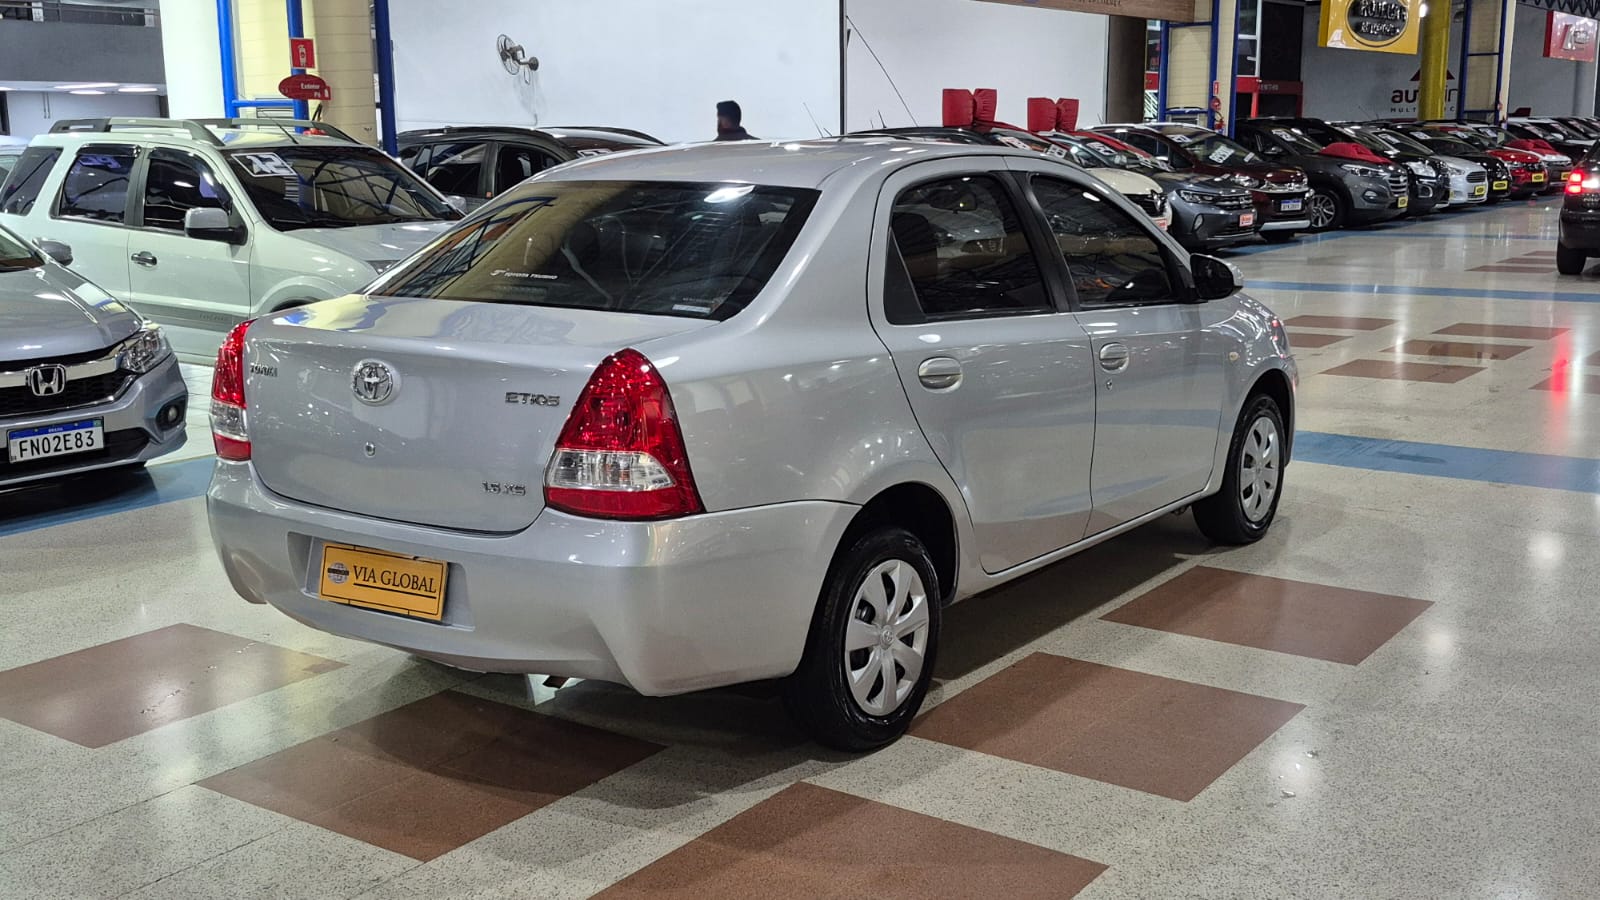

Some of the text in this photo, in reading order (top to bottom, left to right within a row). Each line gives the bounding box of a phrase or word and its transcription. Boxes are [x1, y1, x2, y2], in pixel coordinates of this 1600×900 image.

[505, 392, 560, 407] ETIOS
[353, 565, 377, 583] VIA
[380, 570, 437, 594] GLOBAL
